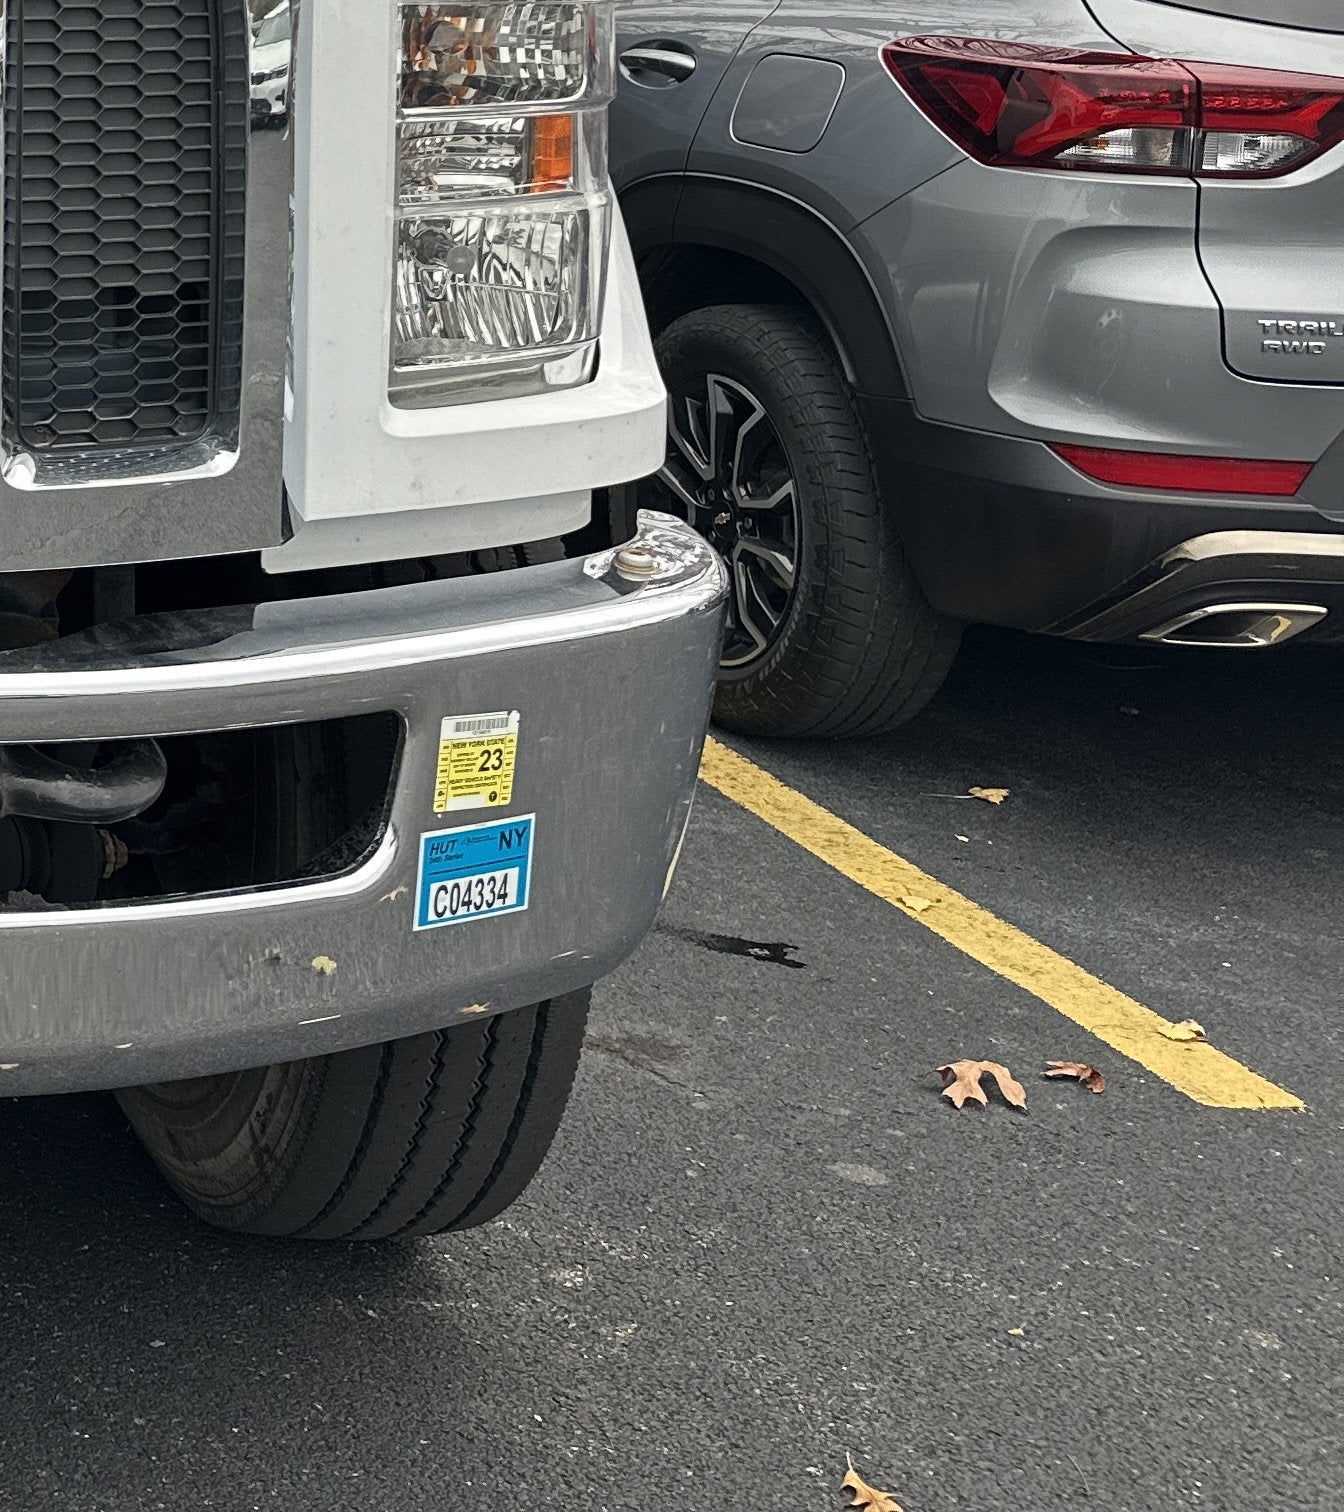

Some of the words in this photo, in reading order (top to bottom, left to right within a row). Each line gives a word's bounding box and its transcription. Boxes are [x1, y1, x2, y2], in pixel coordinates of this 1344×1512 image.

[1257, 319, 1344, 337] TRAIL
[1261, 340, 1326, 354] AWD
[478, 748, 503, 772] 23
[499, 826, 528, 851] NY
[430, 839, 457, 857] HUT
